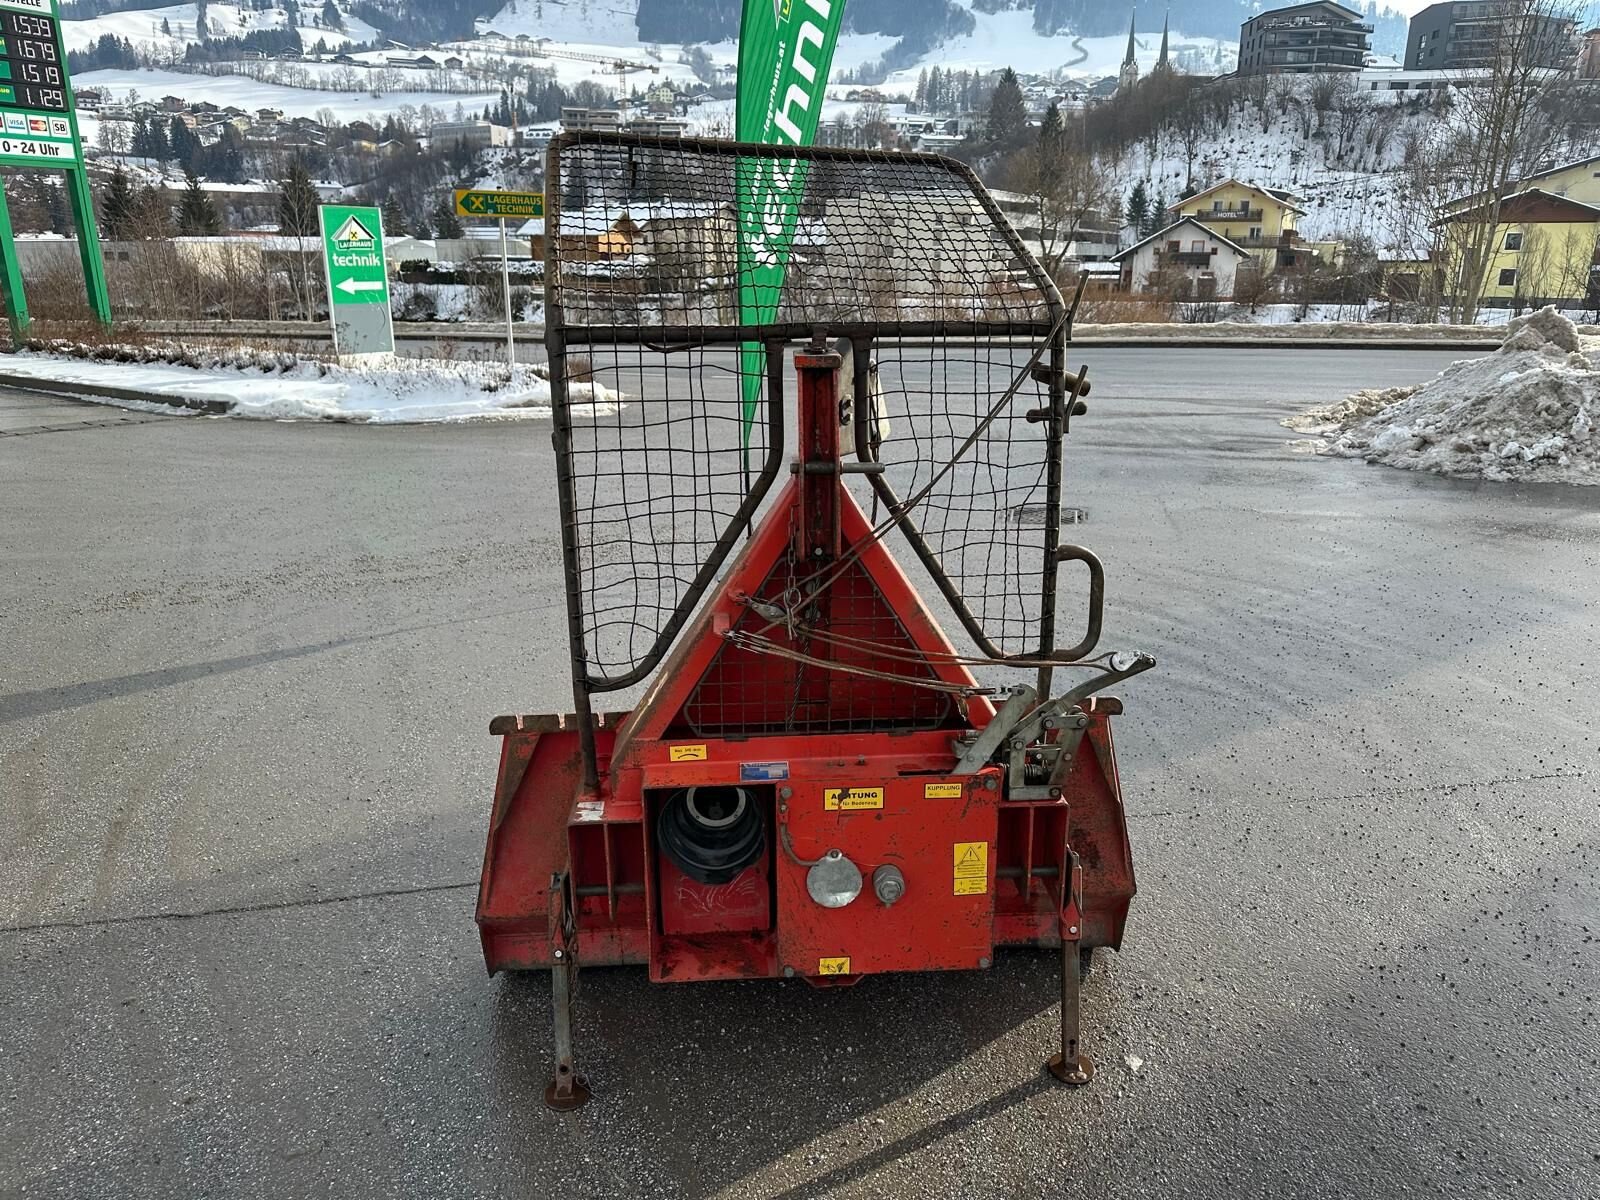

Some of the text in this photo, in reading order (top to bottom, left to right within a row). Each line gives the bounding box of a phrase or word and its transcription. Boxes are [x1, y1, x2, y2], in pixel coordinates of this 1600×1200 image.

[12, 15, 52, 38] 1.539
[17, 39, 56, 62] 1.679
[22, 64, 60, 85] 1.519
[26, 87, 64, 108] 1.129
[54, 123, 66, 132] SB
[2, 140, 11, 153] 0
[20, 142, 36, 154] 24
[39, 143, 60, 156] Uhr
[487, 195, 542, 206] LAGERHAUS
[496, 204, 535, 214] TECHNIK
[339, 241, 372, 249] LAGERHAUS
[332, 253, 381, 267] technik
[831, 792, 878, 800] ATUNG
